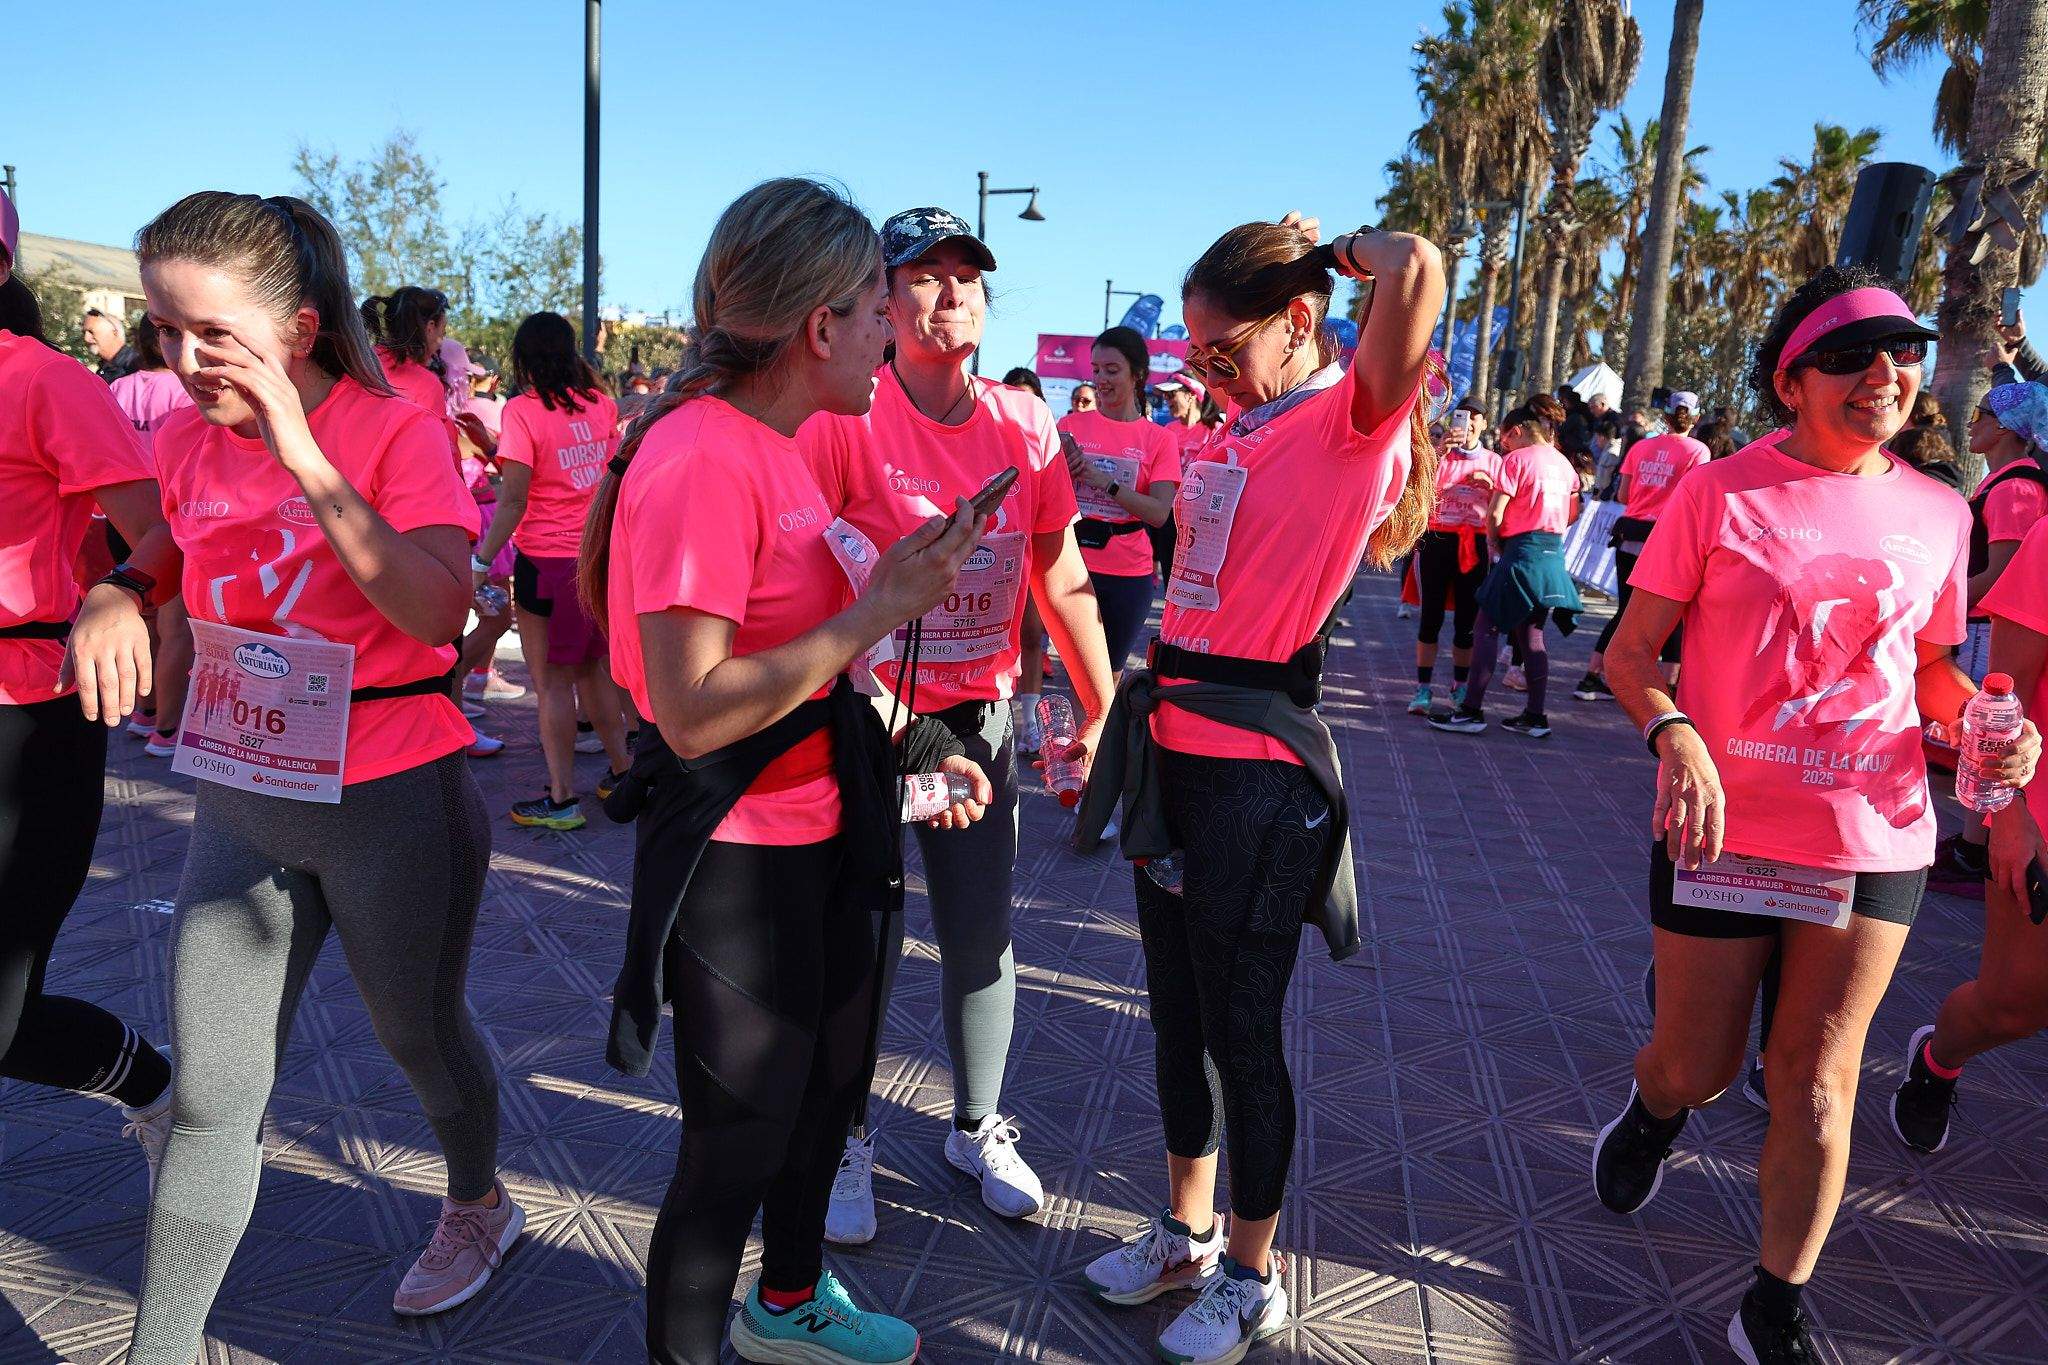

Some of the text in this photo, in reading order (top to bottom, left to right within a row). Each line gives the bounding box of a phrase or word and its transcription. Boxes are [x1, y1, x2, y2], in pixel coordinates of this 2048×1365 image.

[569, 421, 592, 443] TU
[889, 477, 941, 493] OYSHO
[778, 505, 818, 532] OYSHO
[1747, 528, 1822, 541] OYSHO
[944, 593, 992, 612] 016
[953, 618, 976, 628] 5718
[911, 631, 941, 639] CRRERA
[238, 651, 285, 675] ASTURIANA
[233, 700, 286, 735] 016
[239, 734, 264, 749] 5527
[199, 738, 317, 771] CARRERA DE LA MUJER VALENCIA
[1726, 737, 1797, 764] CARRERA
[1802, 748, 1826, 768] DE
[1830, 751, 1850, 769] LA
[192, 755, 319, 791] OYSHO Santander
[1801, 770, 1835, 785] 2025
[1745, 866, 1777, 878] 6325
[1696, 873, 1829, 897] CARRERA DE LA MUJER VALENCIA
[1691, 888, 1830, 916] OYSHO Santander
